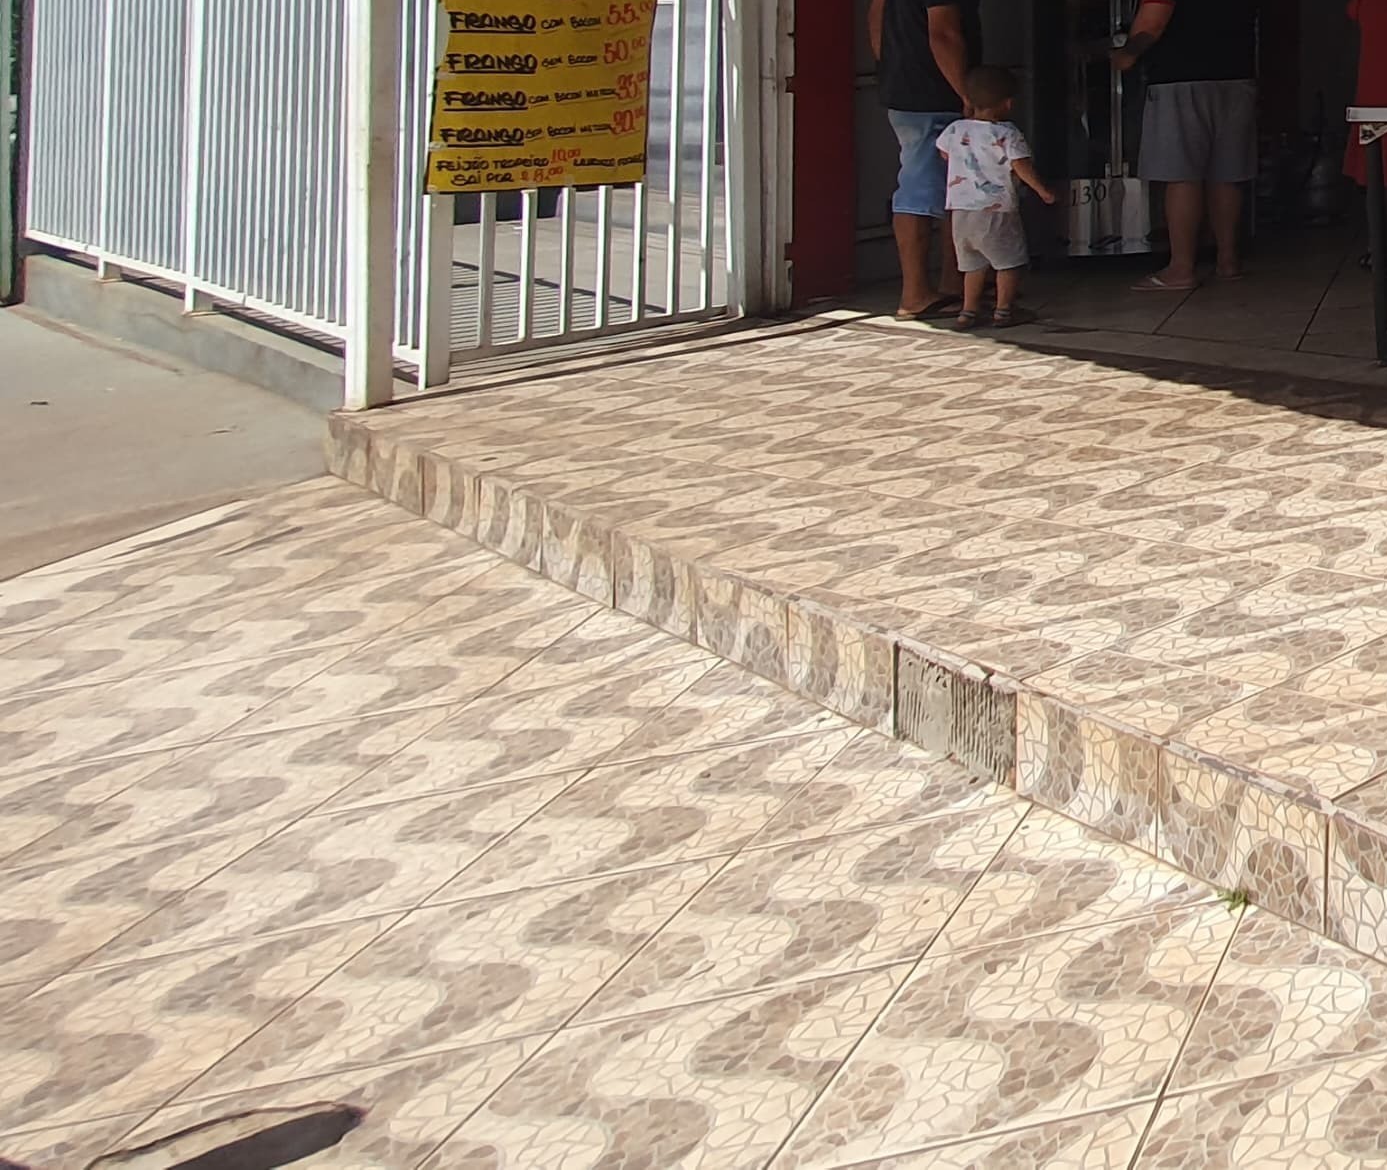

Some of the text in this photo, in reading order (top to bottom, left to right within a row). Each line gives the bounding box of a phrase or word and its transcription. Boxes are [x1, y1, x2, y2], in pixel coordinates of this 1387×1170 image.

[448, 11, 537, 30] FRANGO
[445, 53, 538, 71] FRANGO
[443, 91, 527, 107] FRANGO
[440, 128, 525, 143] FRANGO
